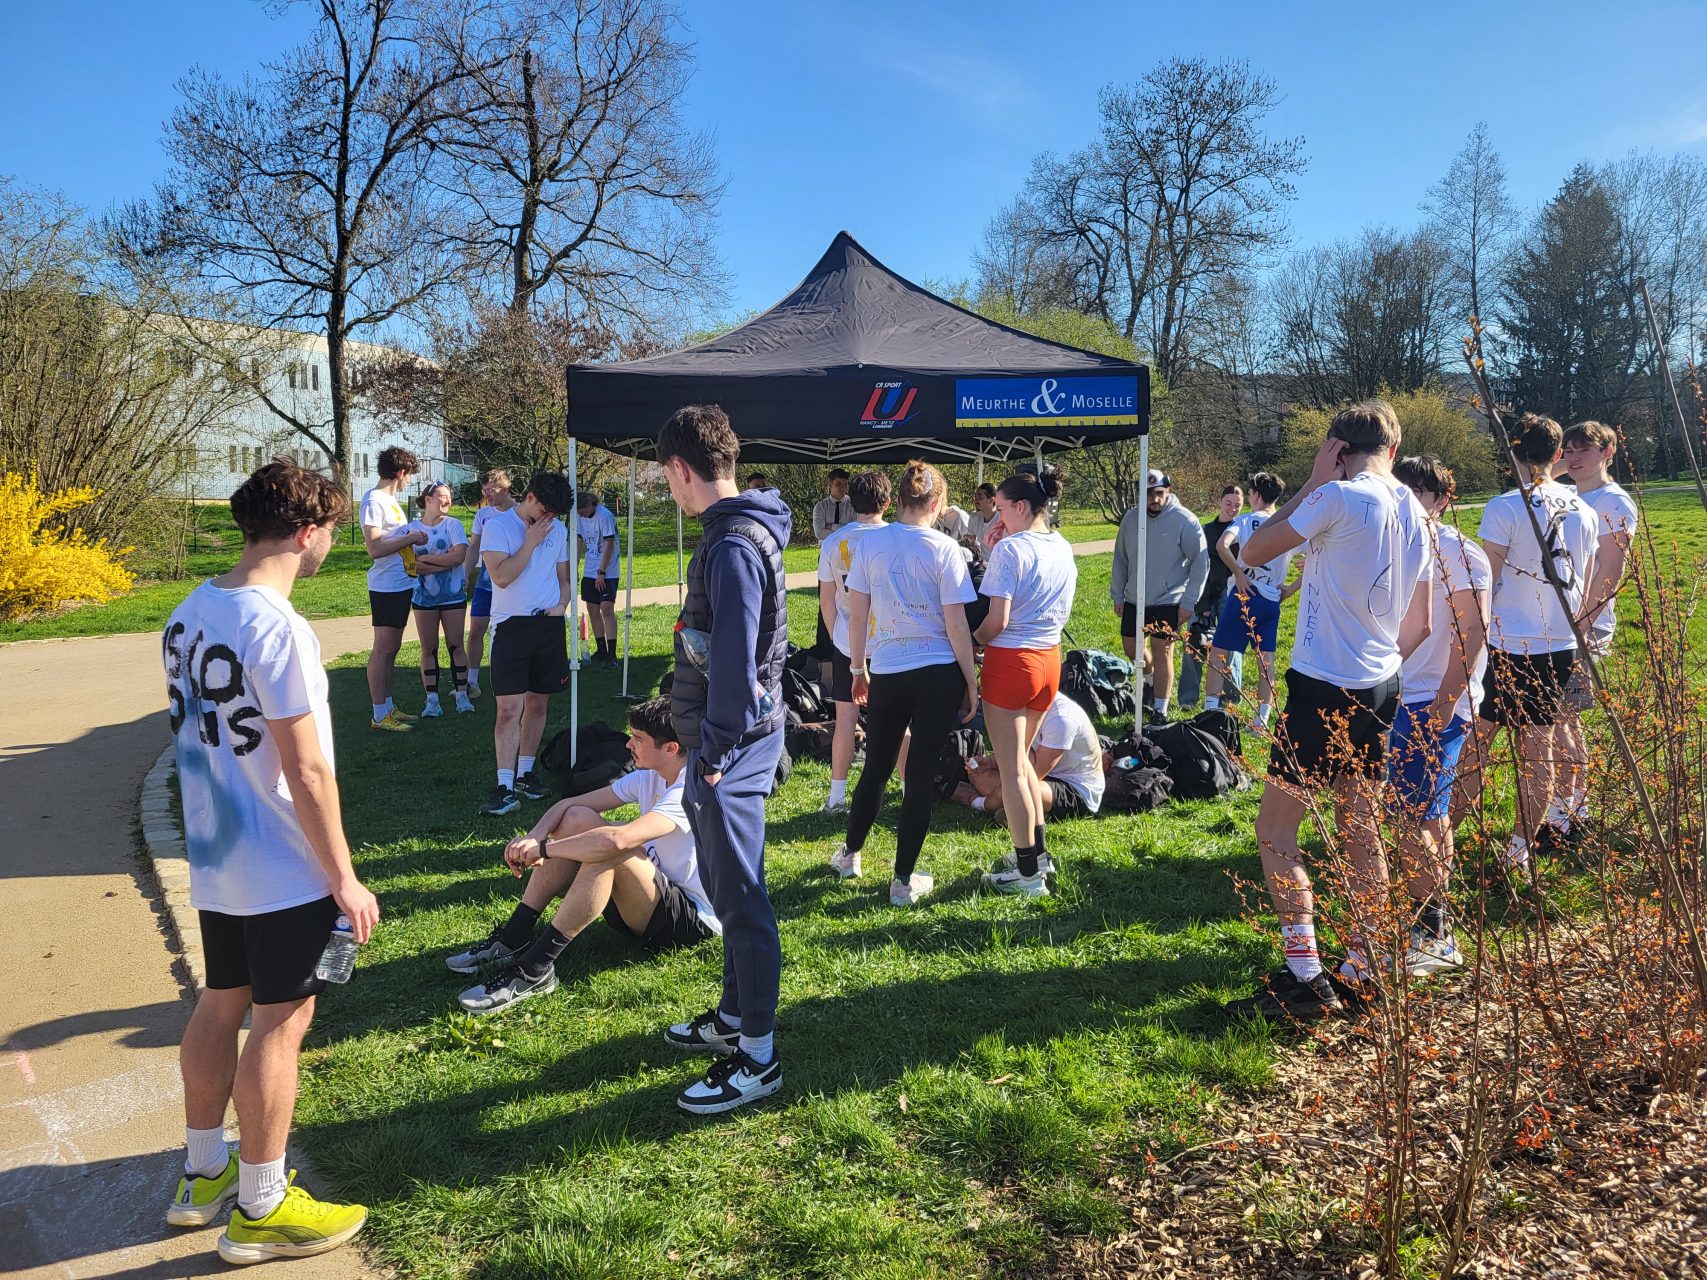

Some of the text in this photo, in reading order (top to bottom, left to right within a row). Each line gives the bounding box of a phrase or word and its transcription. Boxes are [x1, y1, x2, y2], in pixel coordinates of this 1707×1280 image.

[961, 378, 1133, 415] MEURTHE & MOSELLE
[1303, 538, 1323, 648] WINNER
